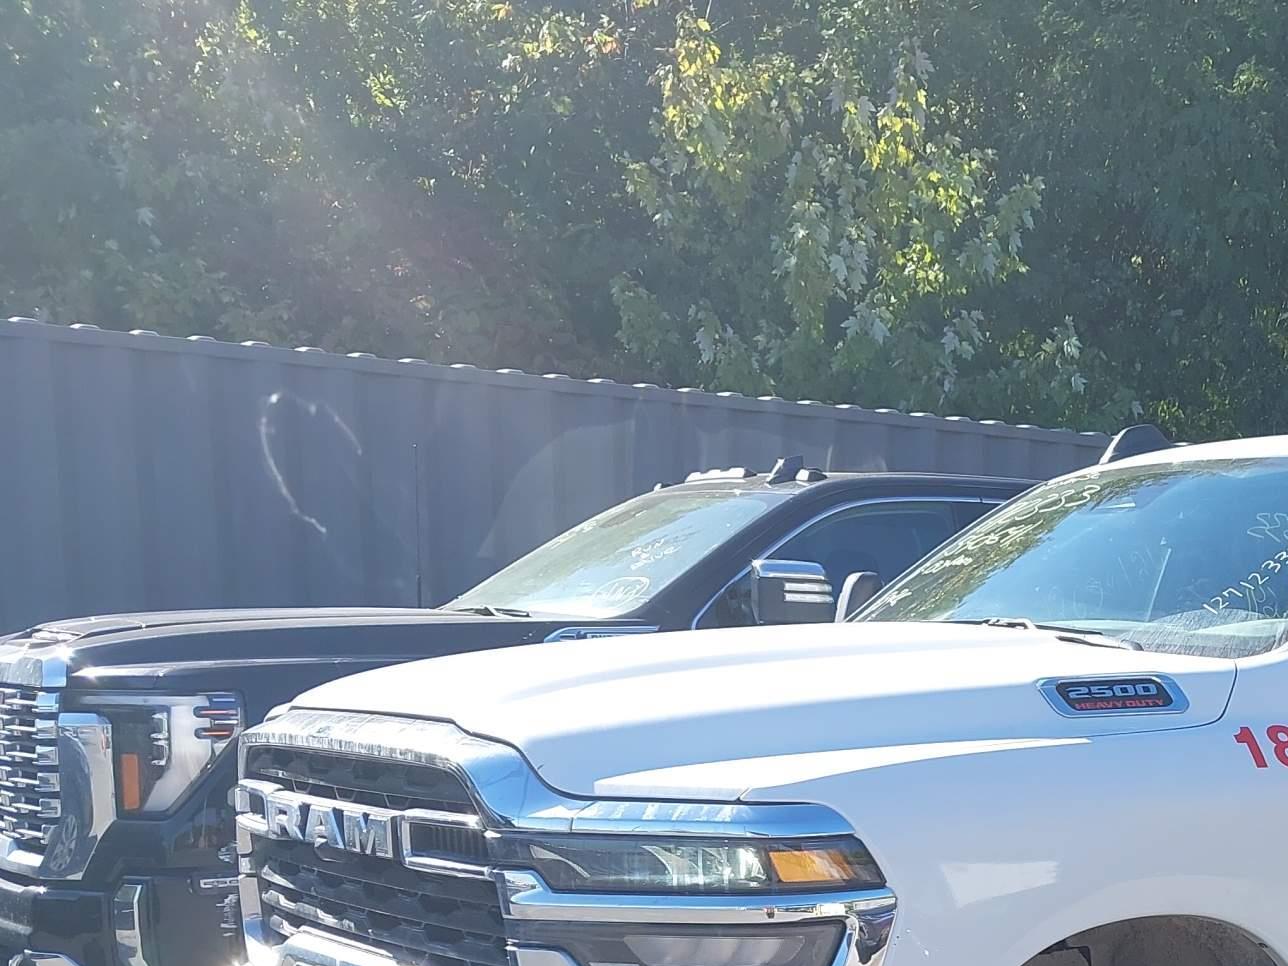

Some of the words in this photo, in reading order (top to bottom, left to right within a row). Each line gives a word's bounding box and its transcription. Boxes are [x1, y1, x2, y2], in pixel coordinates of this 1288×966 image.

[1066, 683, 1158, 698] 2500
[1075, 701, 1123, 710] HEAVY
[1126, 699, 1164, 707] DUTY
[266, 794, 395, 858] RAM
